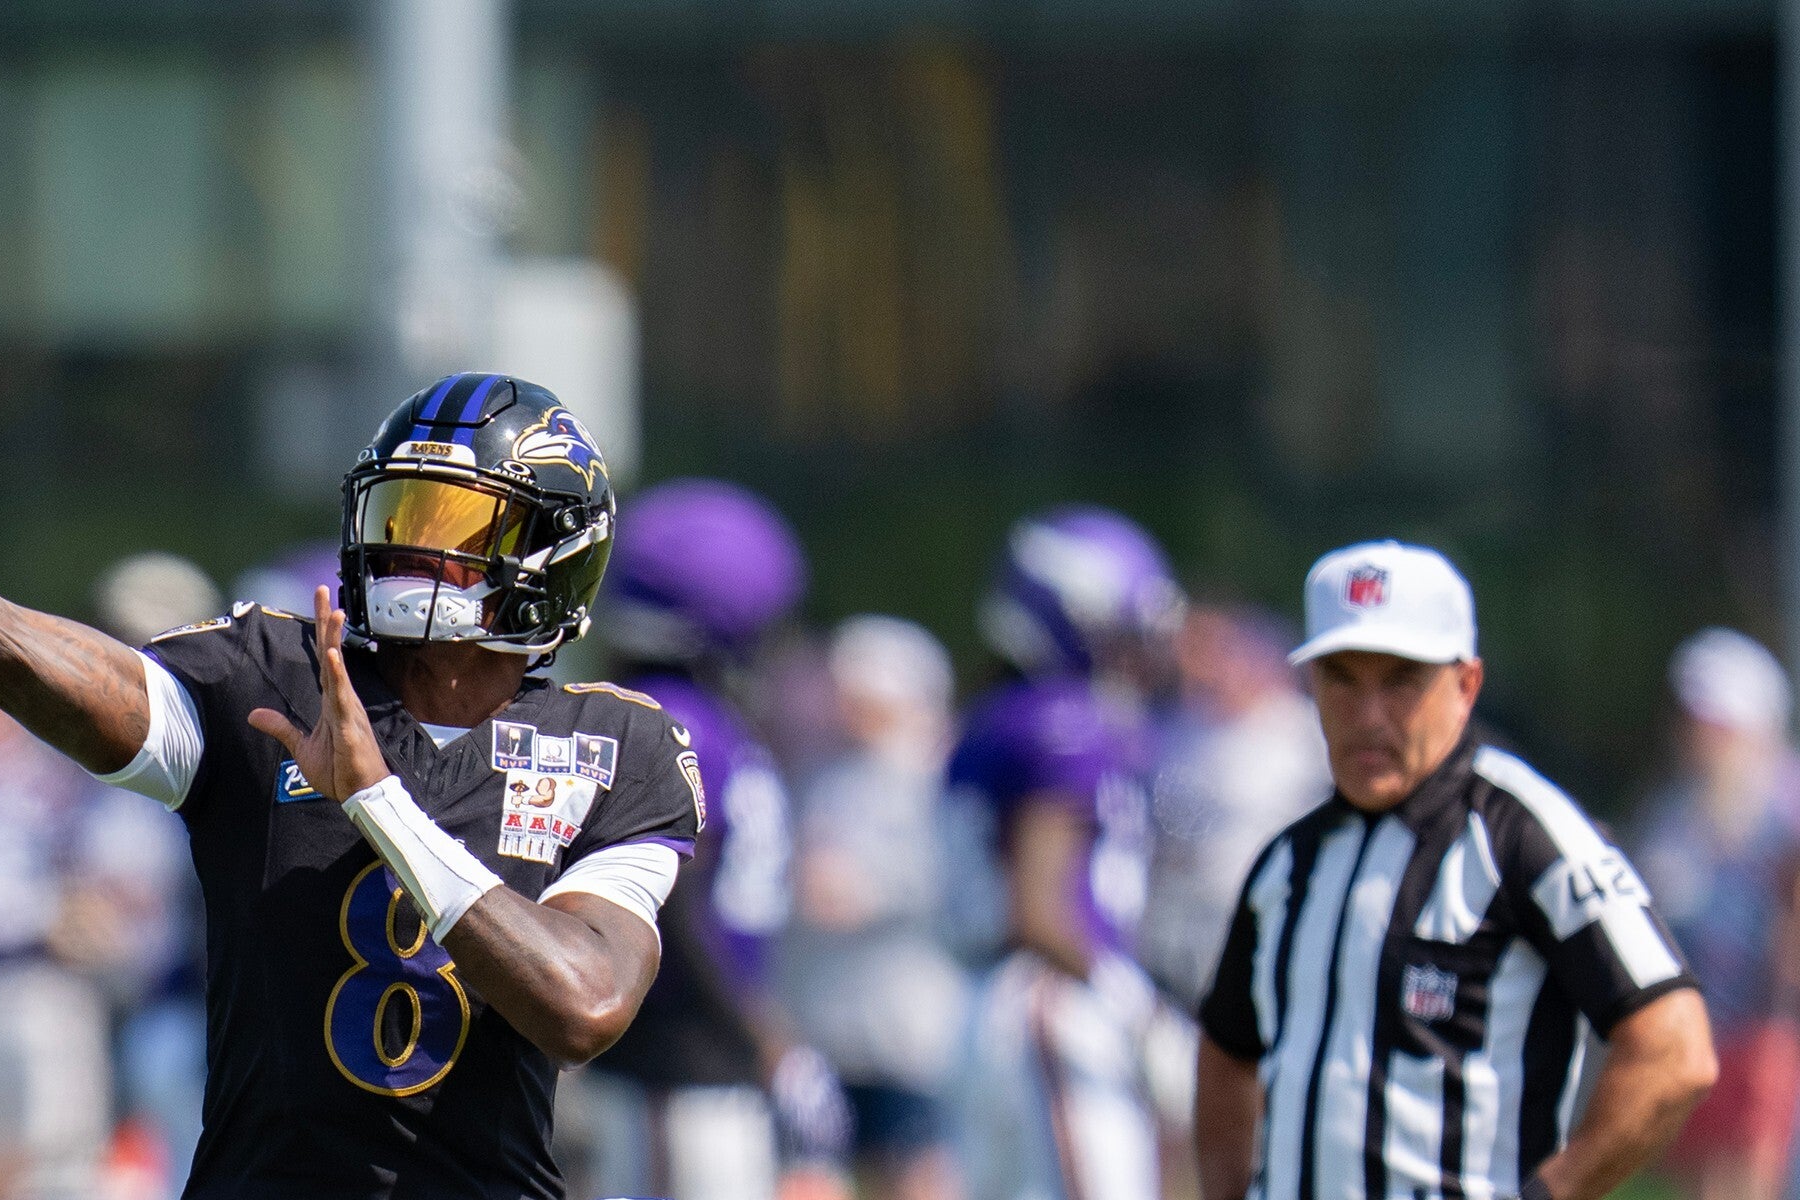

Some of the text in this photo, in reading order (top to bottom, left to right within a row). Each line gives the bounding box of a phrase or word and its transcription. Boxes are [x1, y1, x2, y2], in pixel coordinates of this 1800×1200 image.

[410, 442, 454, 457] RAVENS
[500, 757, 528, 768] MVP
[580, 766, 608, 780] MVP
[1566, 856, 1637, 905] 42
[324, 858, 470, 1097] 8
